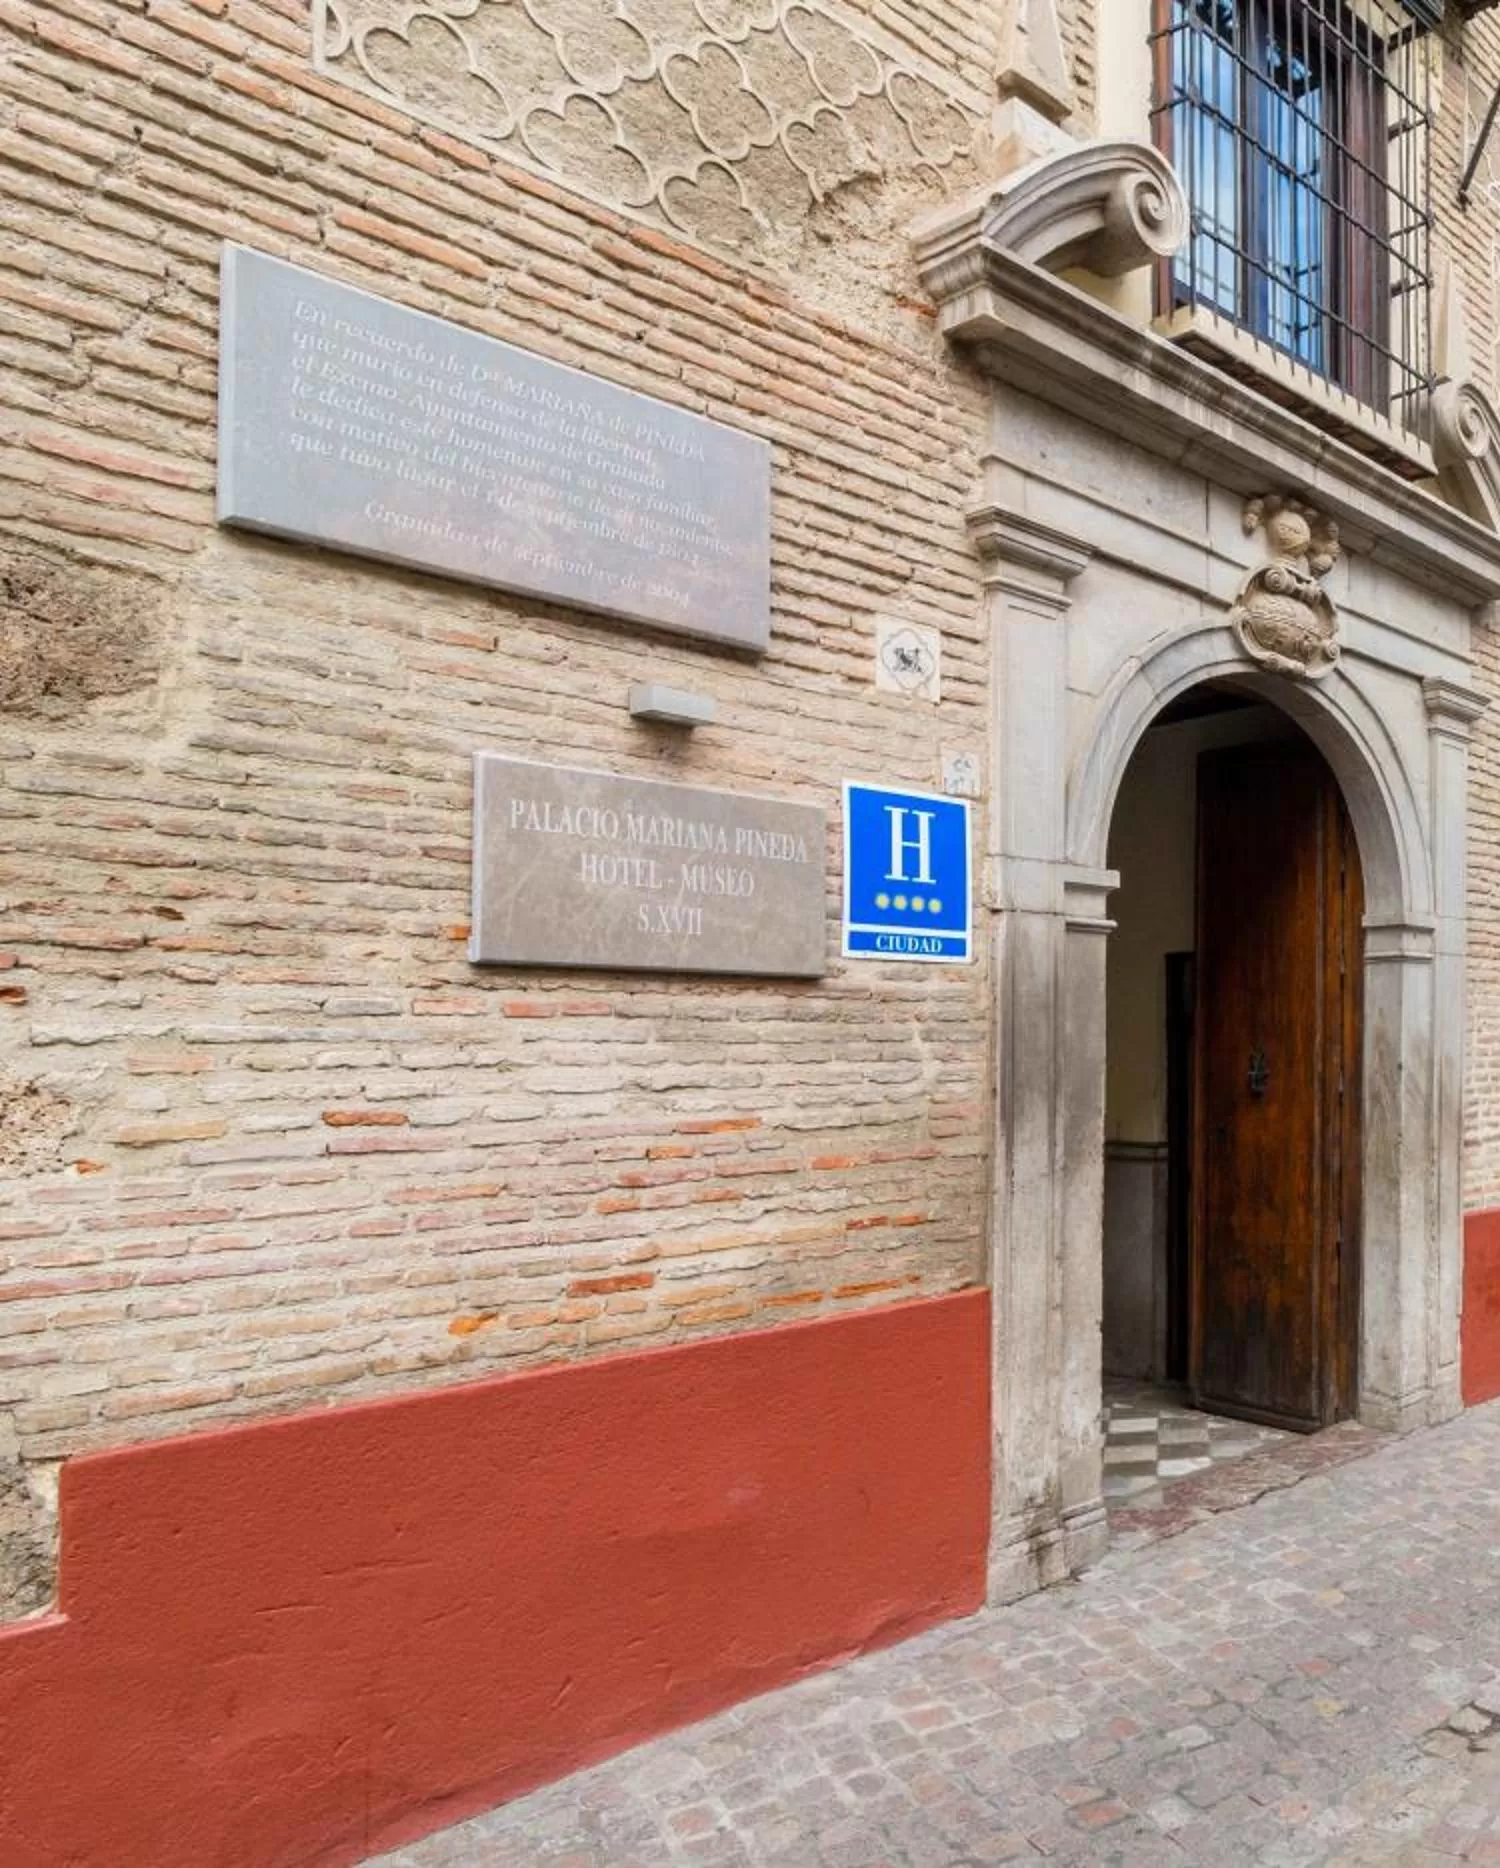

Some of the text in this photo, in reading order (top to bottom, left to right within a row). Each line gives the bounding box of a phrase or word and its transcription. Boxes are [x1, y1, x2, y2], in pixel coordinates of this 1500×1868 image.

[292, 329, 337, 358] que
[416, 372, 443, 394] en
[447, 377, 530, 423] defensa
[558, 416, 577, 439] la
[294, 297, 327, 327] En
[334, 317, 434, 365] recuerdo
[608, 410, 630, 435] de
[290, 374, 314, 401] le
[318, 383, 397, 427] dedica
[549, 464, 573, 483] en
[291, 353, 313, 375] el
[586, 448, 665, 490] Granada
[339, 420, 421, 459] motivo
[423, 442, 458, 470] del
[289, 431, 333, 458] que
[338, 442, 391, 475] tuvo
[460, 481, 480, 501] el
[510, 799, 808, 865] PALACIO MARIANA PINEDA
[884, 805, 937, 884] H
[579, 852, 662, 889] HOTEL
[680, 862, 755, 897] MUSEO
[637, 903, 702, 935] S.XVII
[875, 933, 943, 954] CIUDAD
